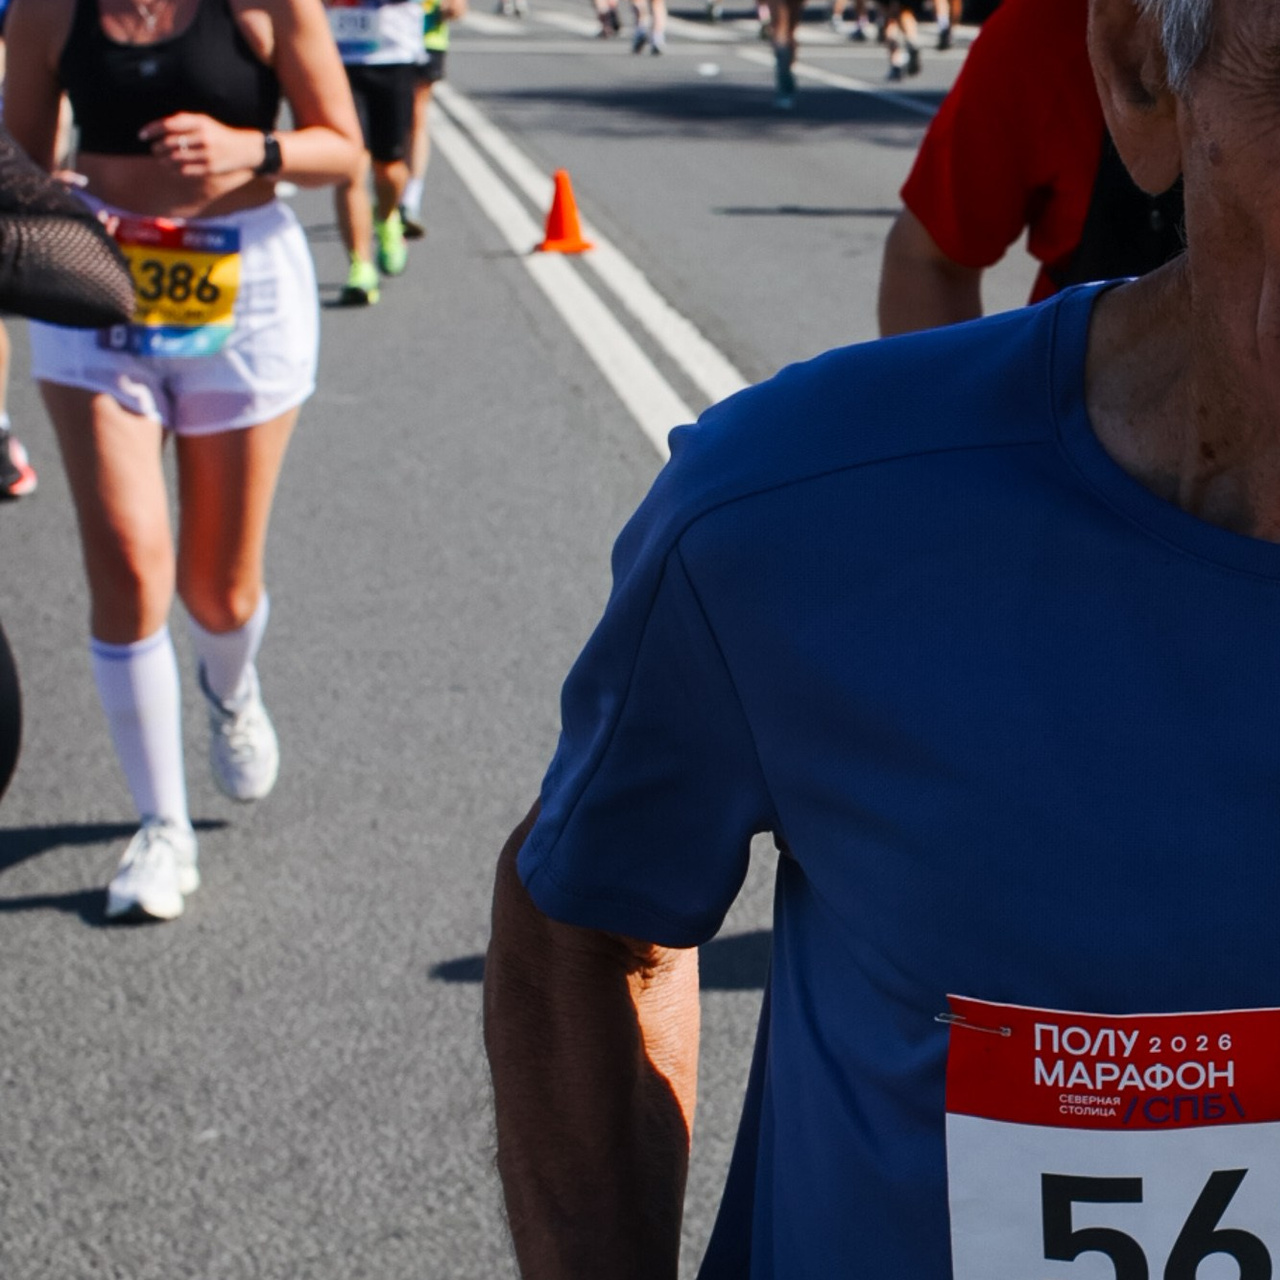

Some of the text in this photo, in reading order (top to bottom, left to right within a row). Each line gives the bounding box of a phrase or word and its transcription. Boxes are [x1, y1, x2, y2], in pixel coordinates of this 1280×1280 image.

[126, 259, 221, 303] 386
[1034, 1022, 1233, 1058] ПОЛУ 2026
[1034, 1057, 1235, 1091] МАРАФОН
[1058, 1093, 1122, 1106] СЕВЕРНАЯ
[1058, 1105, 1117, 1117] СТОЛИЦА
